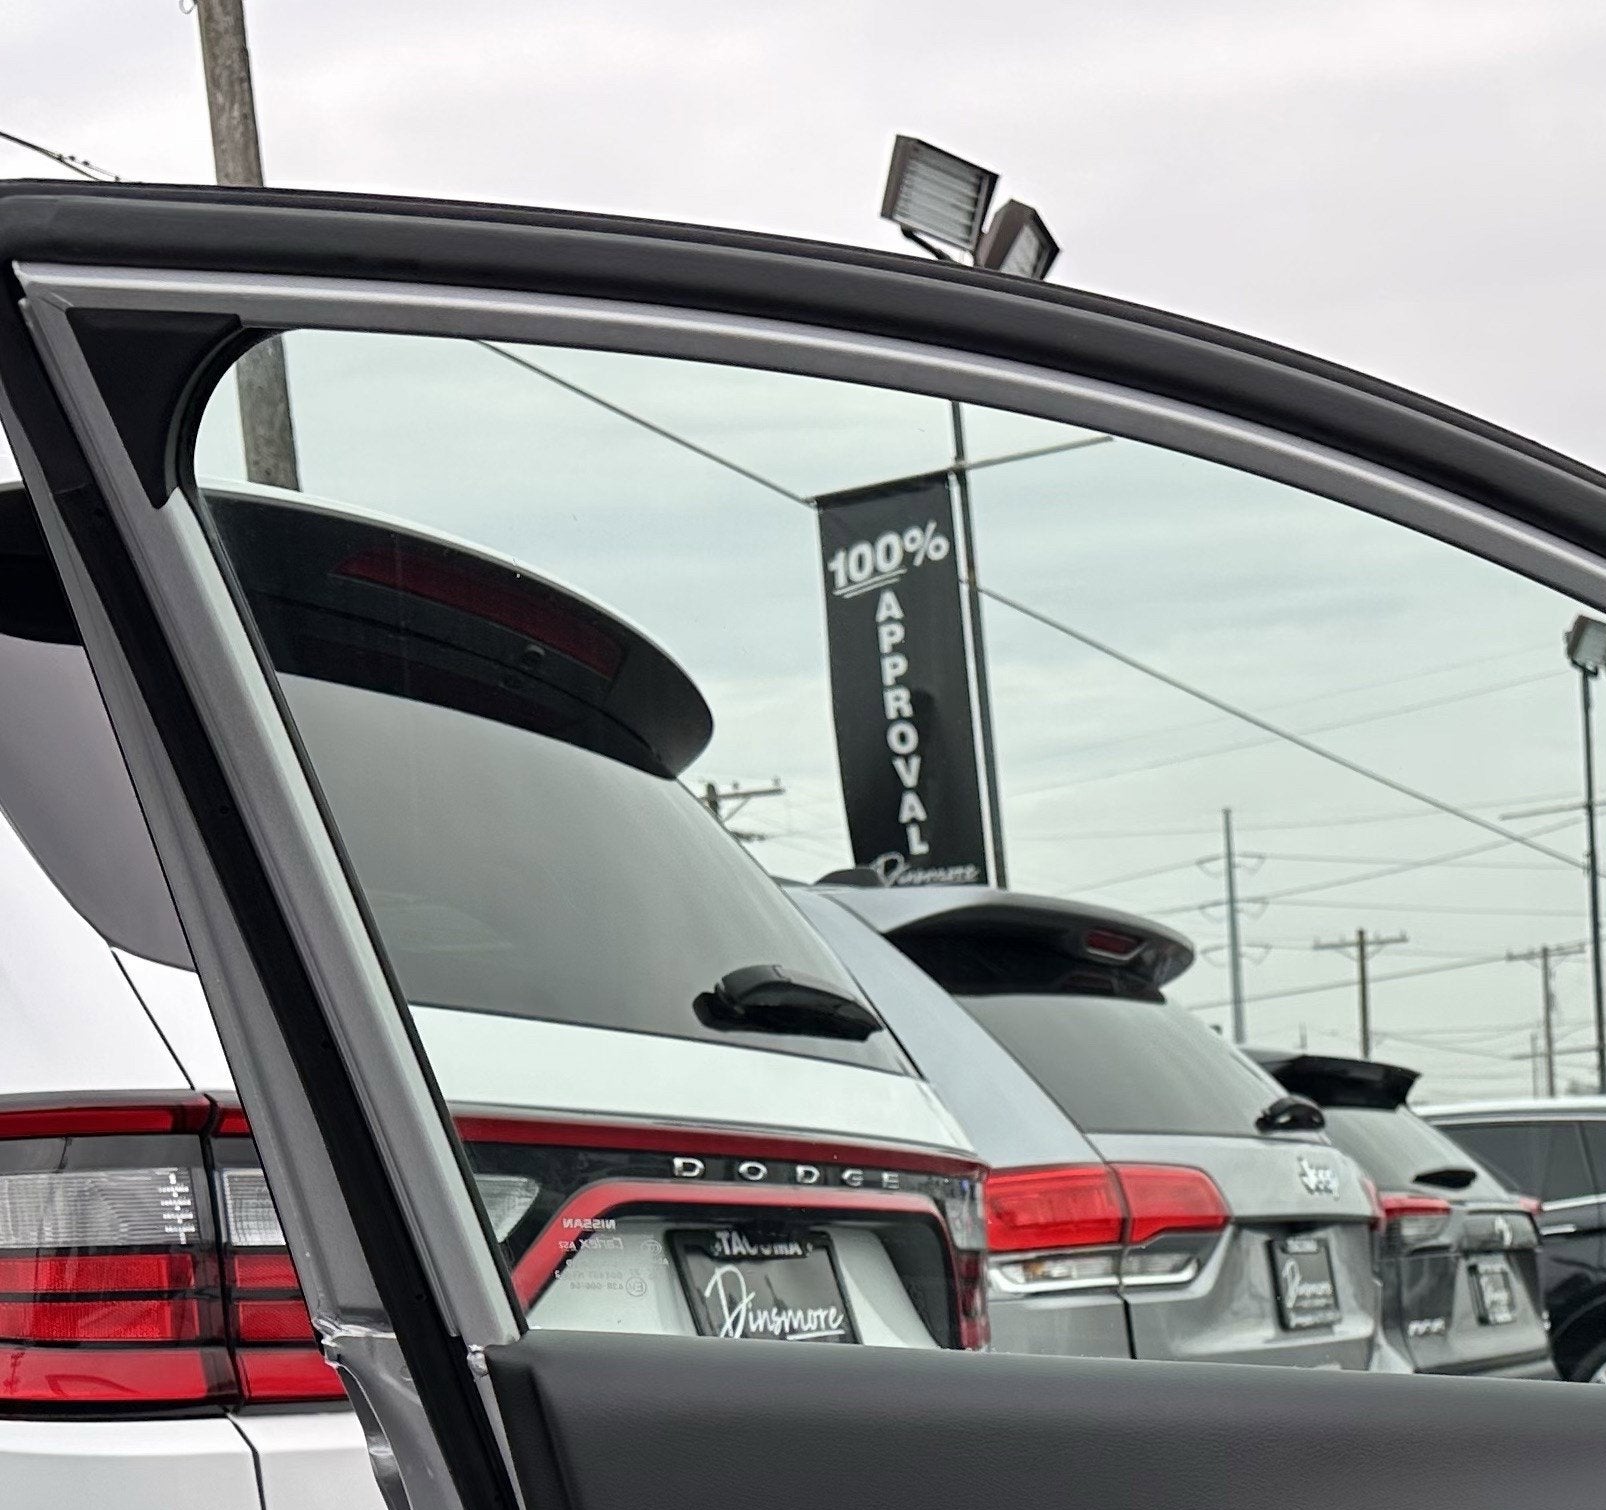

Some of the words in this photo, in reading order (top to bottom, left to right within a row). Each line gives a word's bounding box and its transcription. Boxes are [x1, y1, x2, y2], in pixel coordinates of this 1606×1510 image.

[828, 520, 949, 586] 100%
[875, 589, 929, 856] APPROVAL
[673, 1156, 900, 1189] DODGE
[704, 1264, 844, 1338] Dinsmore
